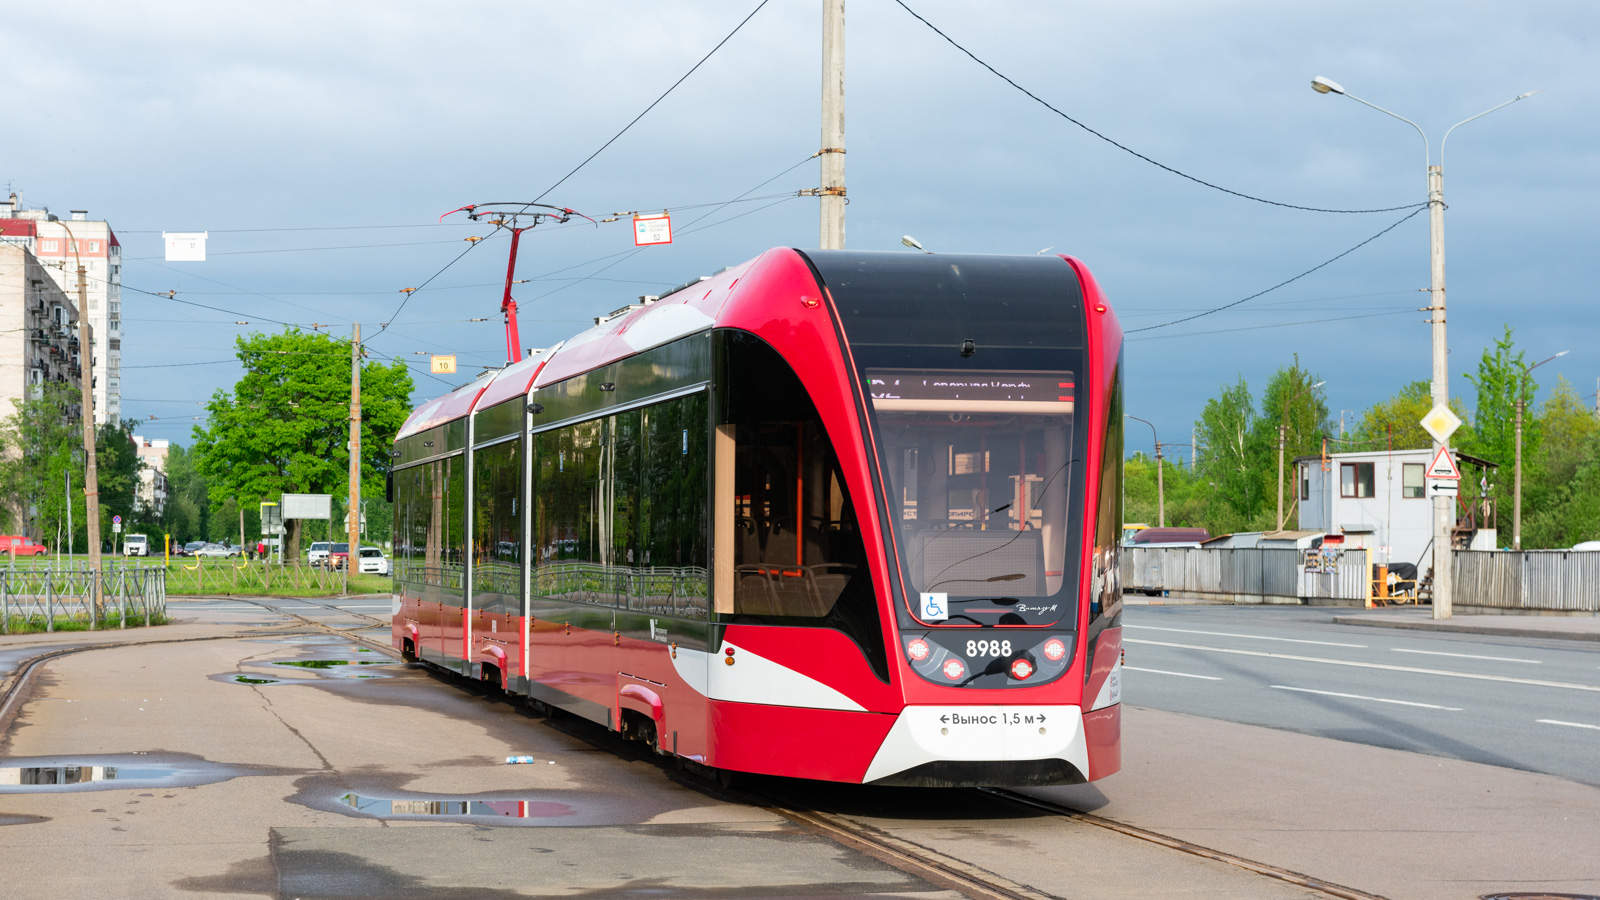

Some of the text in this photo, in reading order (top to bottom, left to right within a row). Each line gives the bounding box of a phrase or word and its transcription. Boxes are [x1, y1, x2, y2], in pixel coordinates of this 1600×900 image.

[653, 233, 661, 241] 52
[966, 640, 1012, 657] 8988
[952, 713, 1035, 726] Вынос 1,5 м
